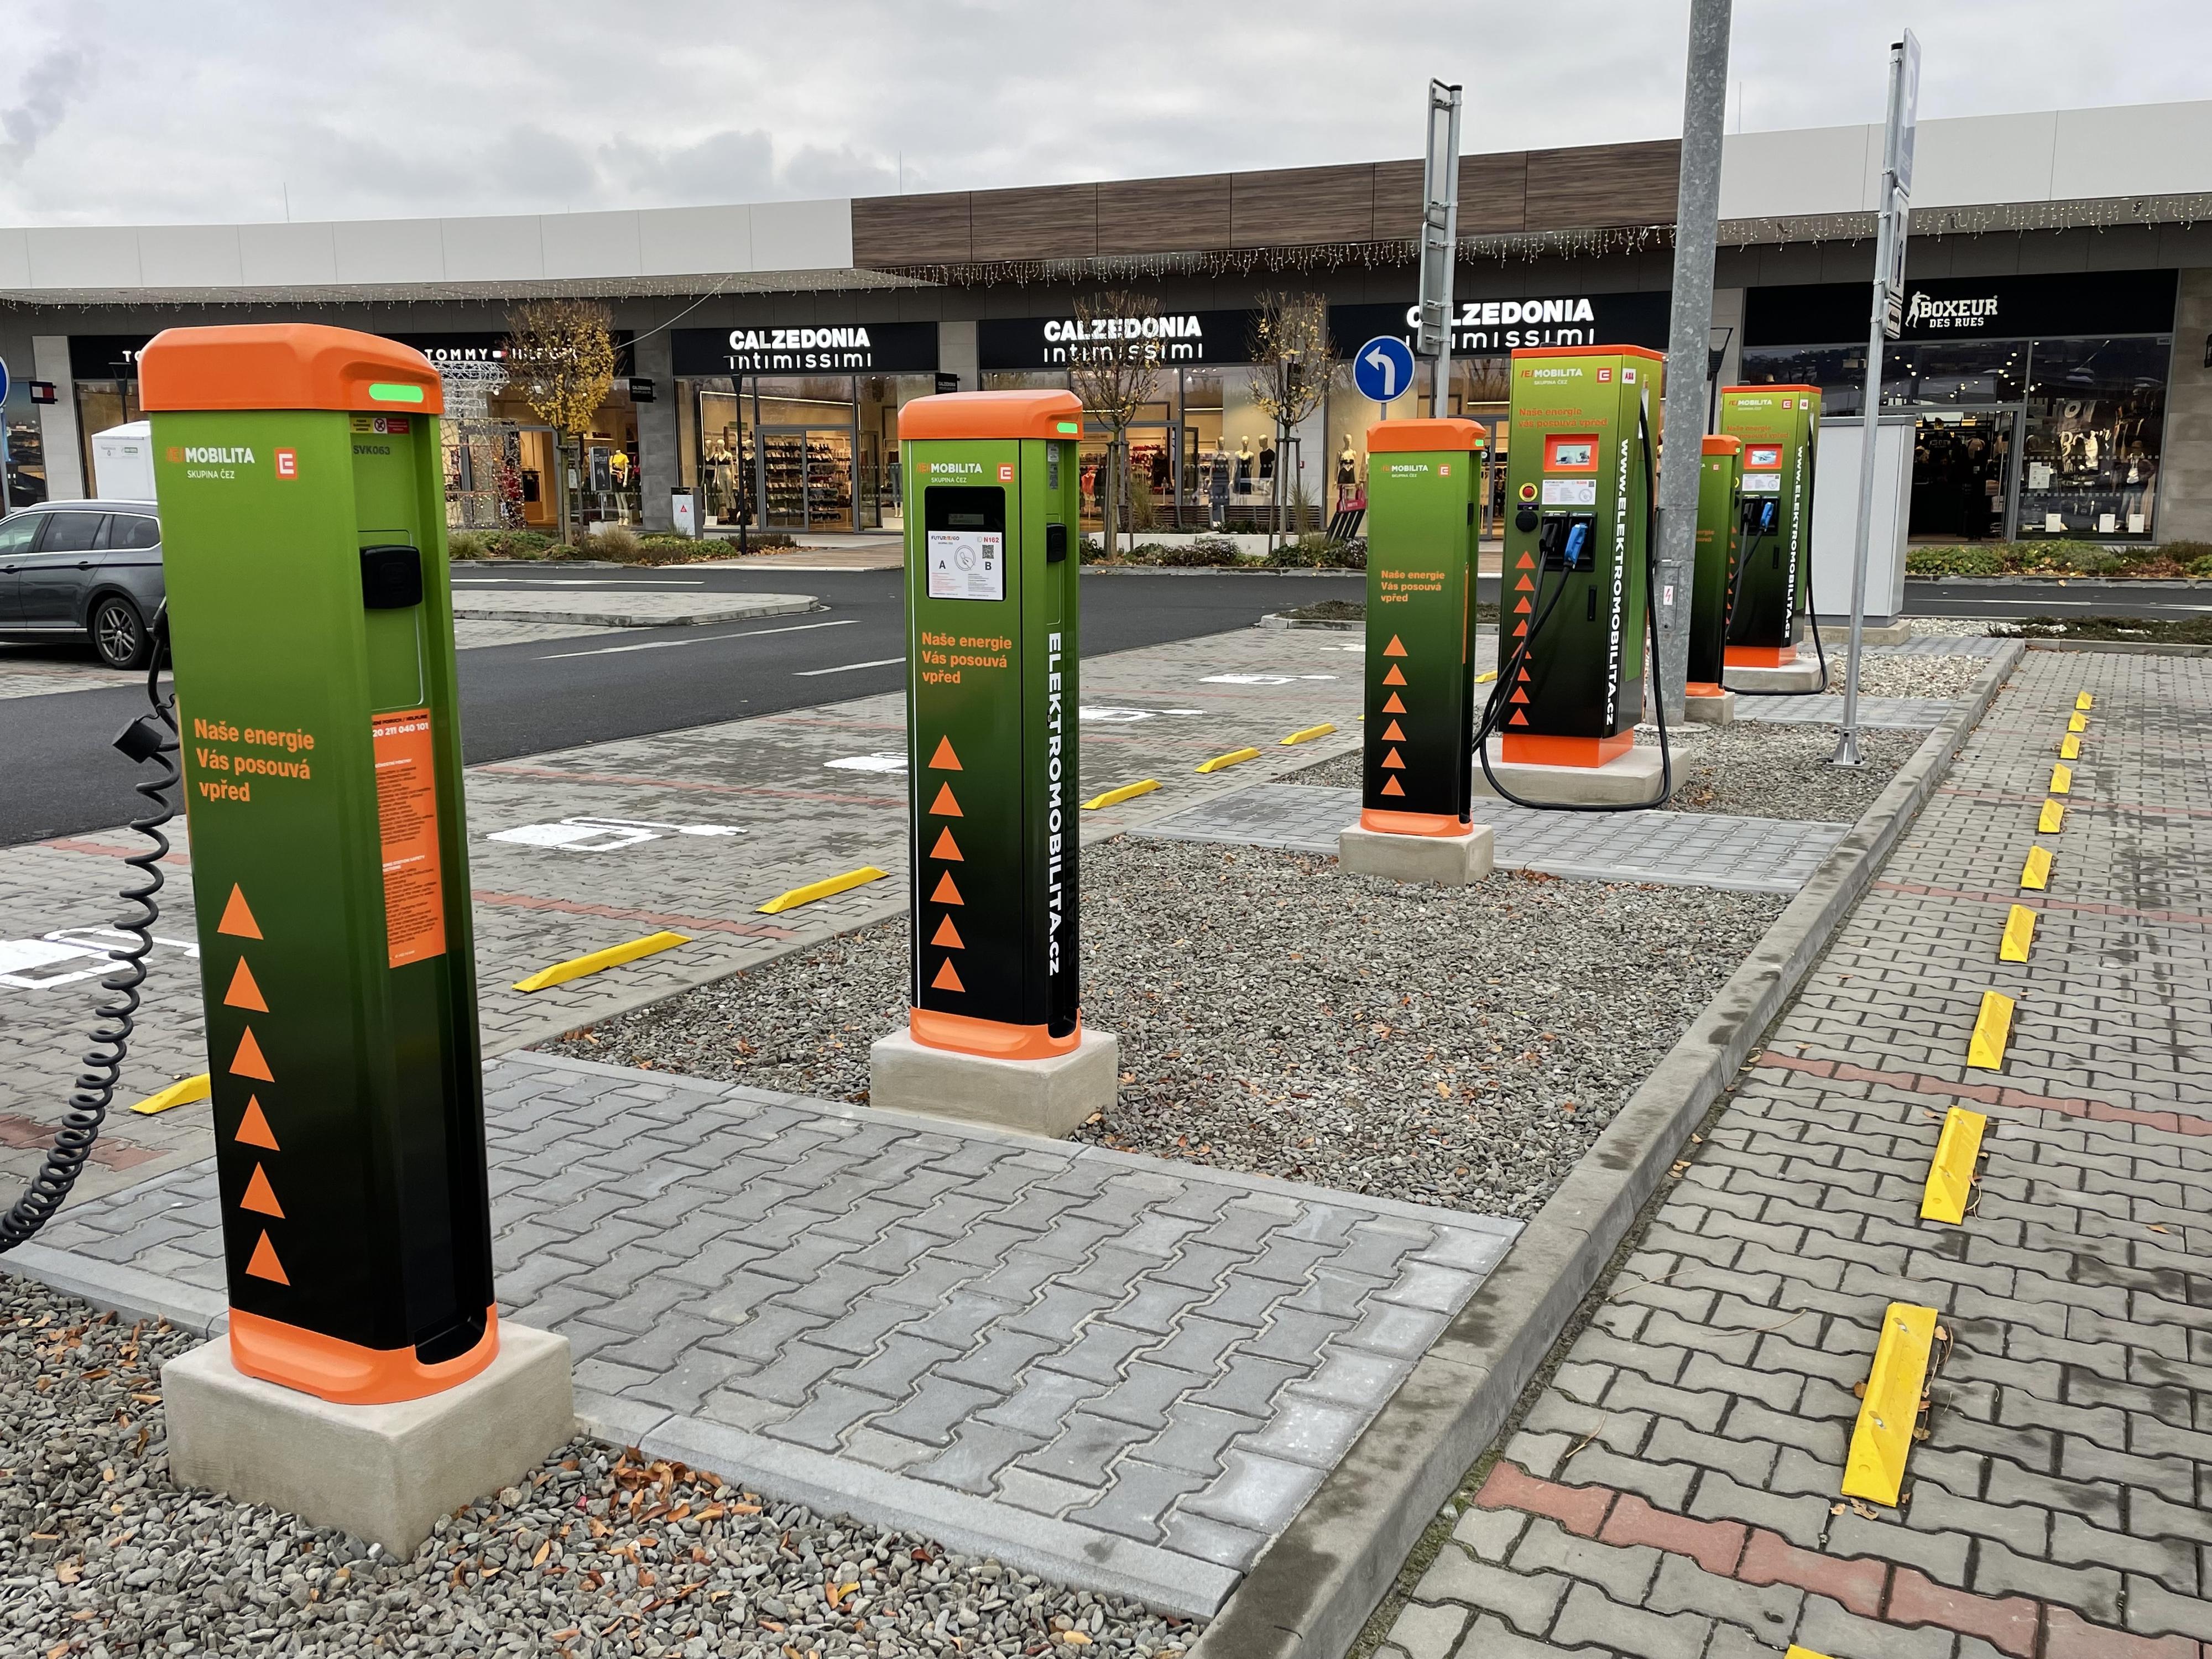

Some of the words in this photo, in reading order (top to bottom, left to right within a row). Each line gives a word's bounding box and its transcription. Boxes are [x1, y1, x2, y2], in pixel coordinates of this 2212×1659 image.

[1406, 298, 1594, 328] CLZEDONIA
[1919, 299, 1998, 318] BOXEUR
[1044, 315, 1202, 342] CALZEDONIA
[1929, 319, 1950, 327] DES
[1955, 317, 1984, 327] RUES
[729, 327, 871, 350] CALZEDONIA
[424, 348, 488, 361] TOMMY
[730, 352, 871, 369] intimissimi
[353, 445, 390, 455] SVK063
[187, 469, 218, 479] SKUPINA
[220, 468, 235, 479] ČEZ
[939, 560, 946, 569] A
[985, 561, 992, 571] B
[1381, 570, 1405, 579] Naše
[1407, 571, 1446, 581] energie
[1381, 582, 1399, 591] Vás
[1401, 582, 1442, 592] posouvá
[1381, 593, 1408, 603] vpřed
[922, 632, 956, 646] Naše
[959, 636, 1012, 651] energie
[922, 650, 946, 664] Vás
[950, 655, 1007, 668] posouvá
[922, 670, 961, 685] vpřed
[194, 718, 239, 742] Naše
[244, 728, 315, 753] energie
[398, 724, 415, 734] 040
[416, 722, 429, 731] 101
[196, 748, 229, 770] Vás
[234, 758, 310, 780] posouvá
[199, 779, 251, 802] vpřed
